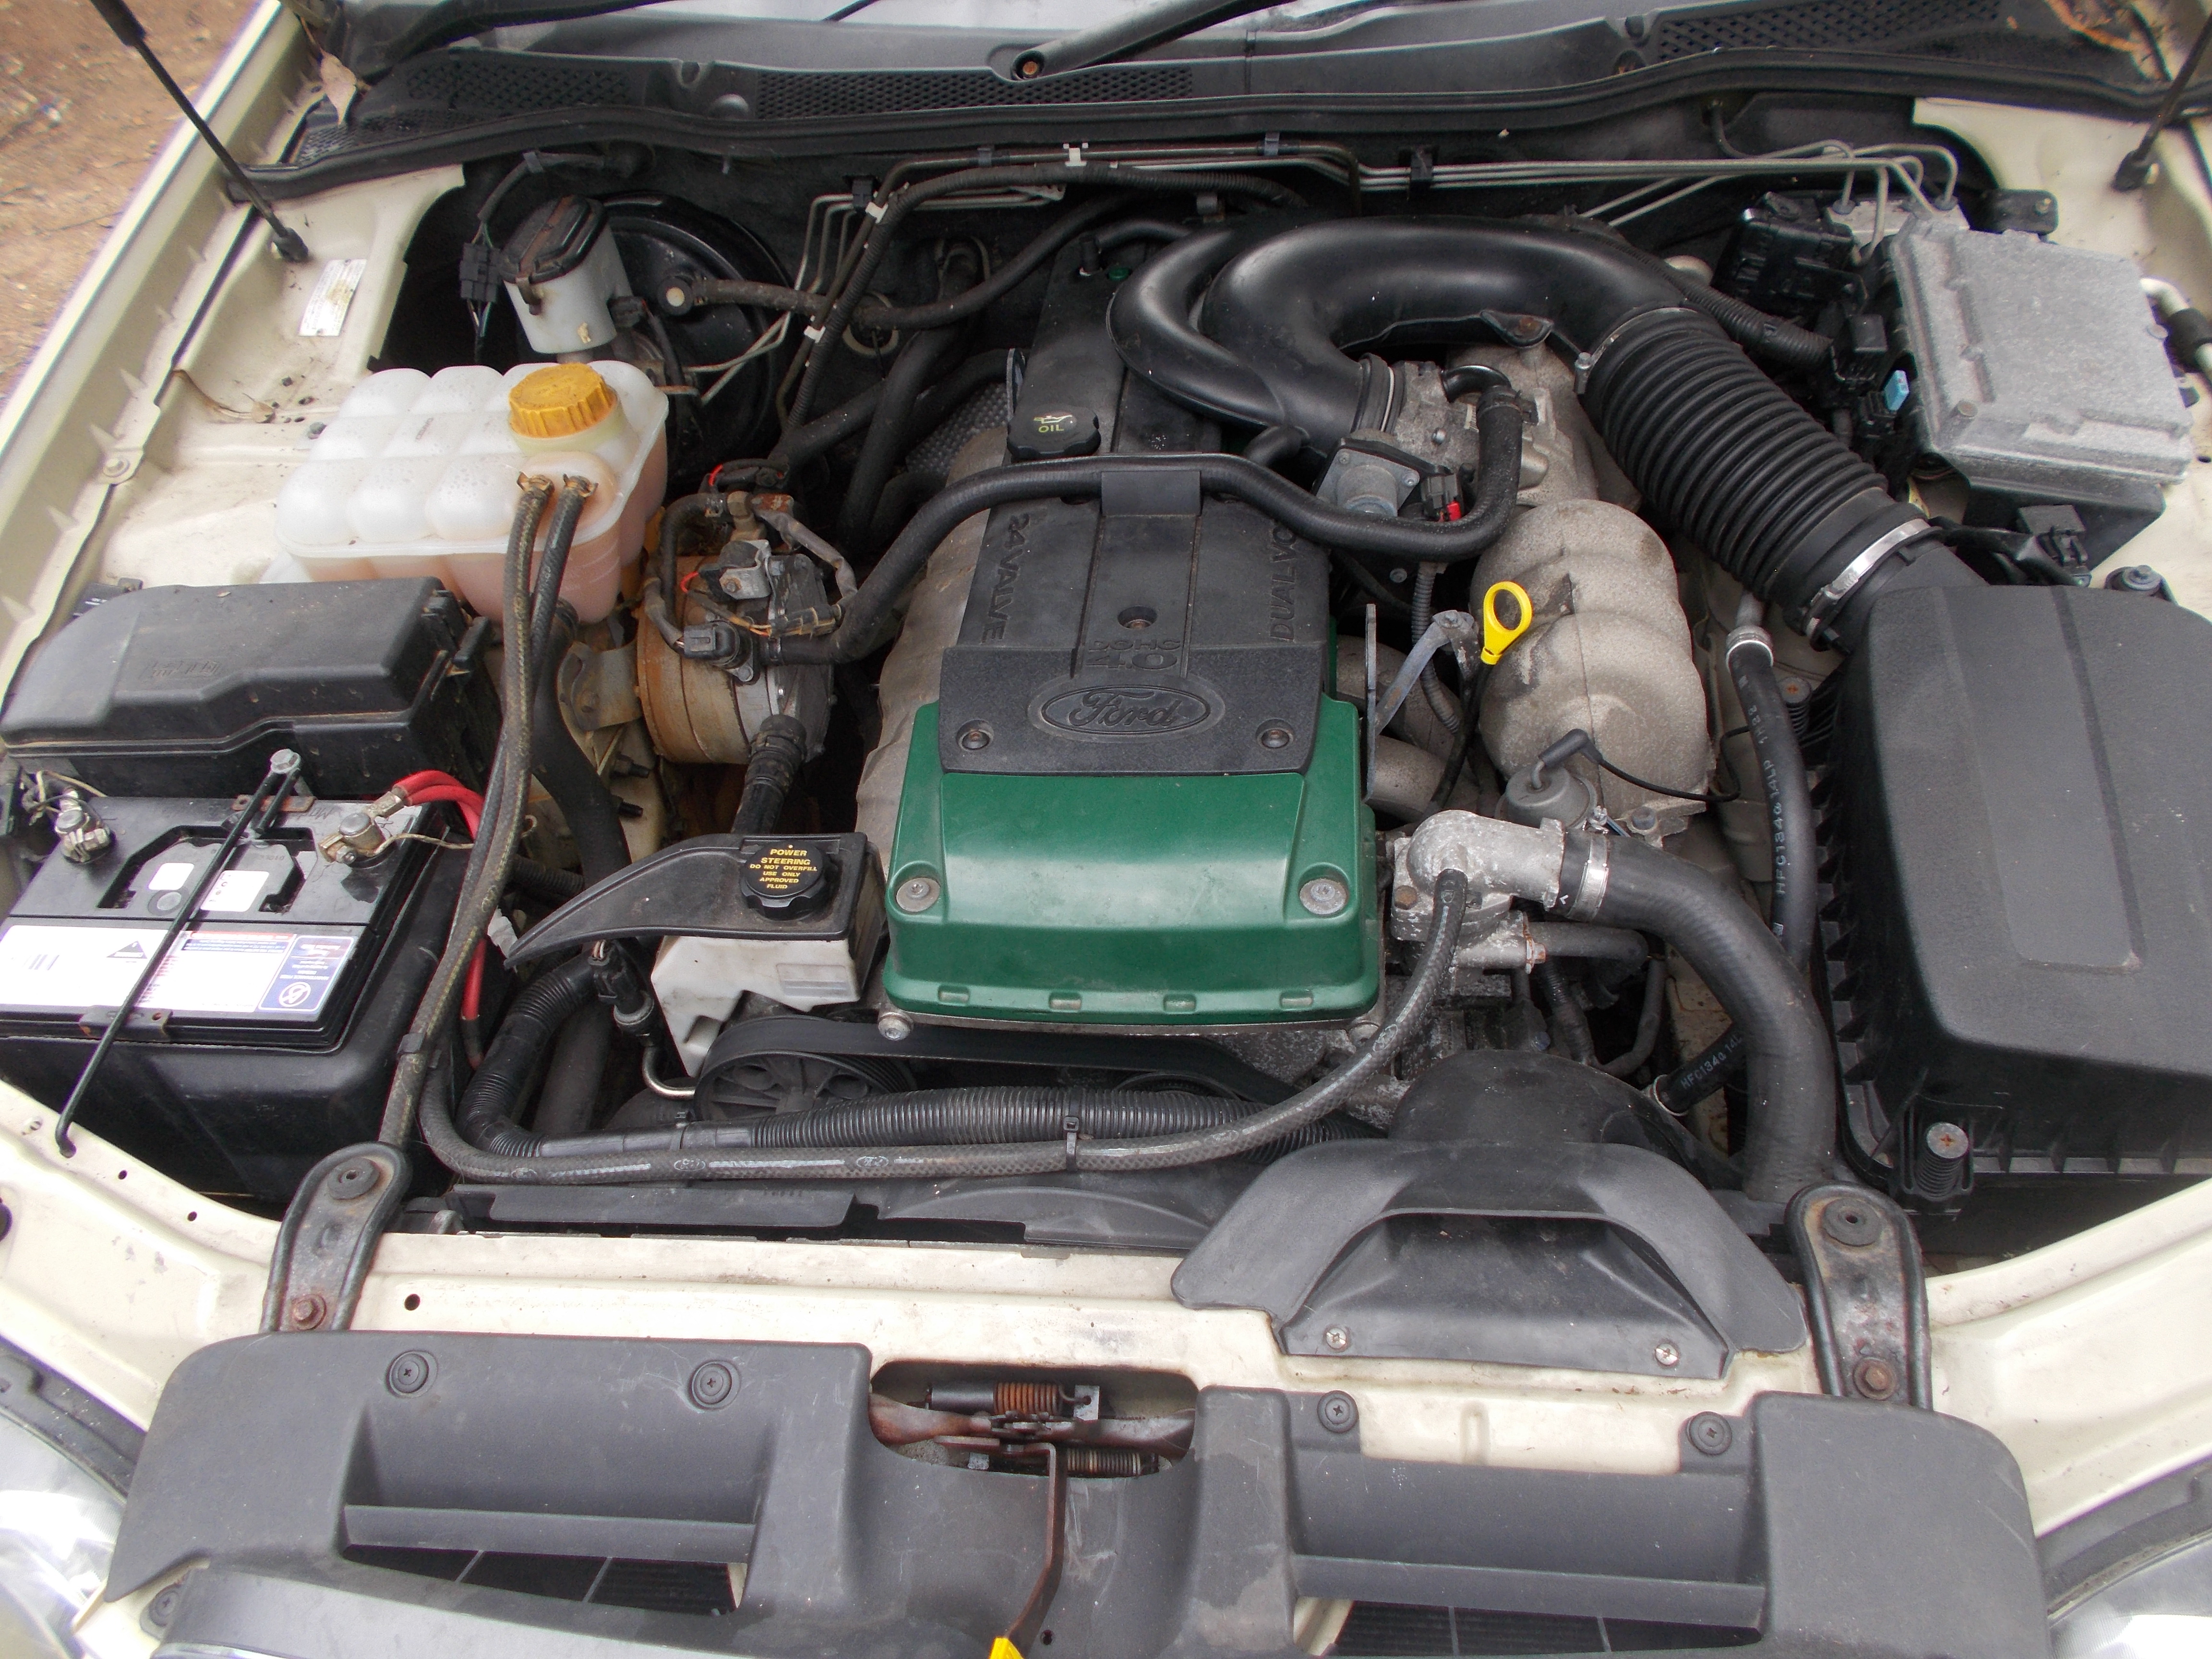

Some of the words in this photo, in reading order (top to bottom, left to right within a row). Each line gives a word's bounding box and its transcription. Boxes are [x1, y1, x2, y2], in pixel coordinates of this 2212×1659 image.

[1038, 424, 1064, 433] OIL
[1088, 639, 1181, 651] DOHC
[1085, 652, 1178, 670] 4.0
[1069, 688, 1183, 727] Ford
